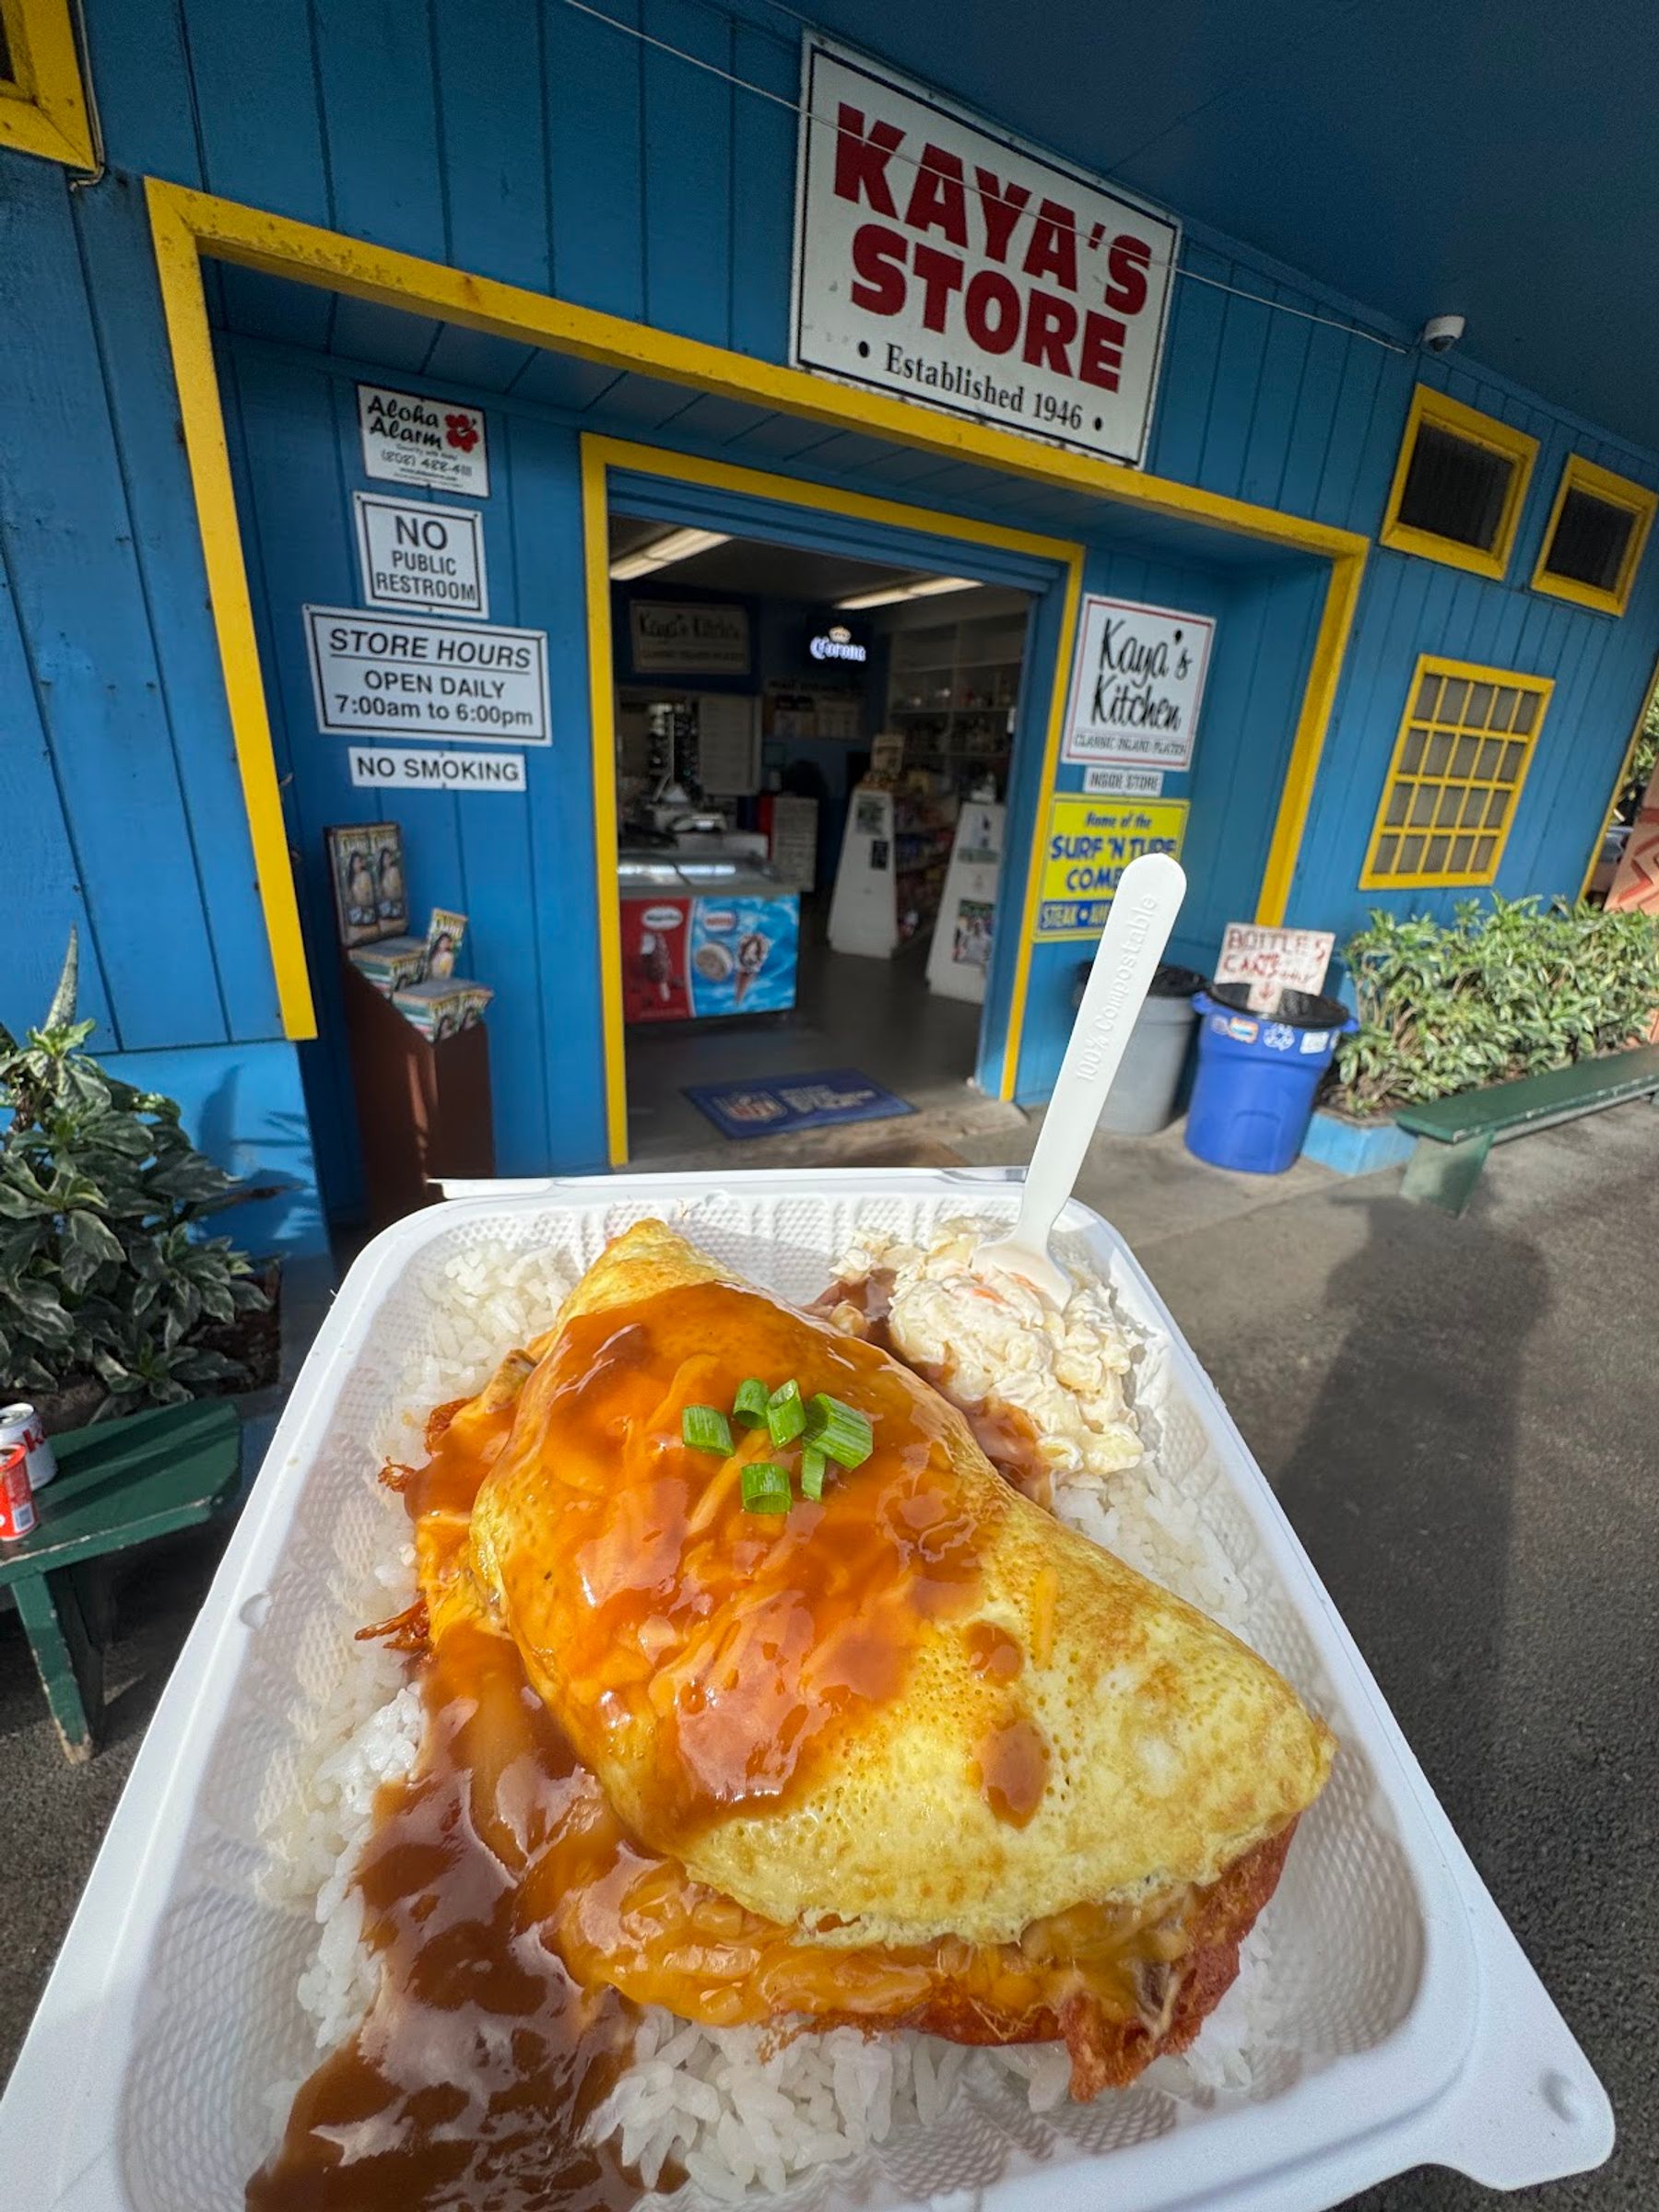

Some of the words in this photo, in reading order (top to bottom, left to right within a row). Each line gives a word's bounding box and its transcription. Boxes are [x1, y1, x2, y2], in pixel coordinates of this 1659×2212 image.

[833, 100, 1153, 316] KAYA'S
[850, 223, 1127, 394] STORE
[885, 343, 1024, 414] Established
[1032, 392, 1083, 430] 1946
[368, 394, 440, 429] Aloha
[370, 417, 442, 451] Alarm
[395, 514, 448, 550] NO
[392, 550, 457, 576] PUBLIC
[375, 571, 477, 602] RESTROOM
[329, 628, 429, 659] STORE
[437, 639, 531, 669] HOURS
[810, 636, 866, 662] Corona
[1099, 618, 1194, 689] Kaya's
[365, 670, 432, 694] OPEN
[441, 677, 505, 699] DAILY
[335, 694, 420, 718] 7:00am
[428, 702, 449, 720] to
[456, 703, 533, 727] 6:00pm
[1090, 674, 1182, 733] Kitchen
[357, 756, 394, 778] NO
[404, 759, 519, 782] SMOKING
[1051, 835, 1103, 860] SURF
